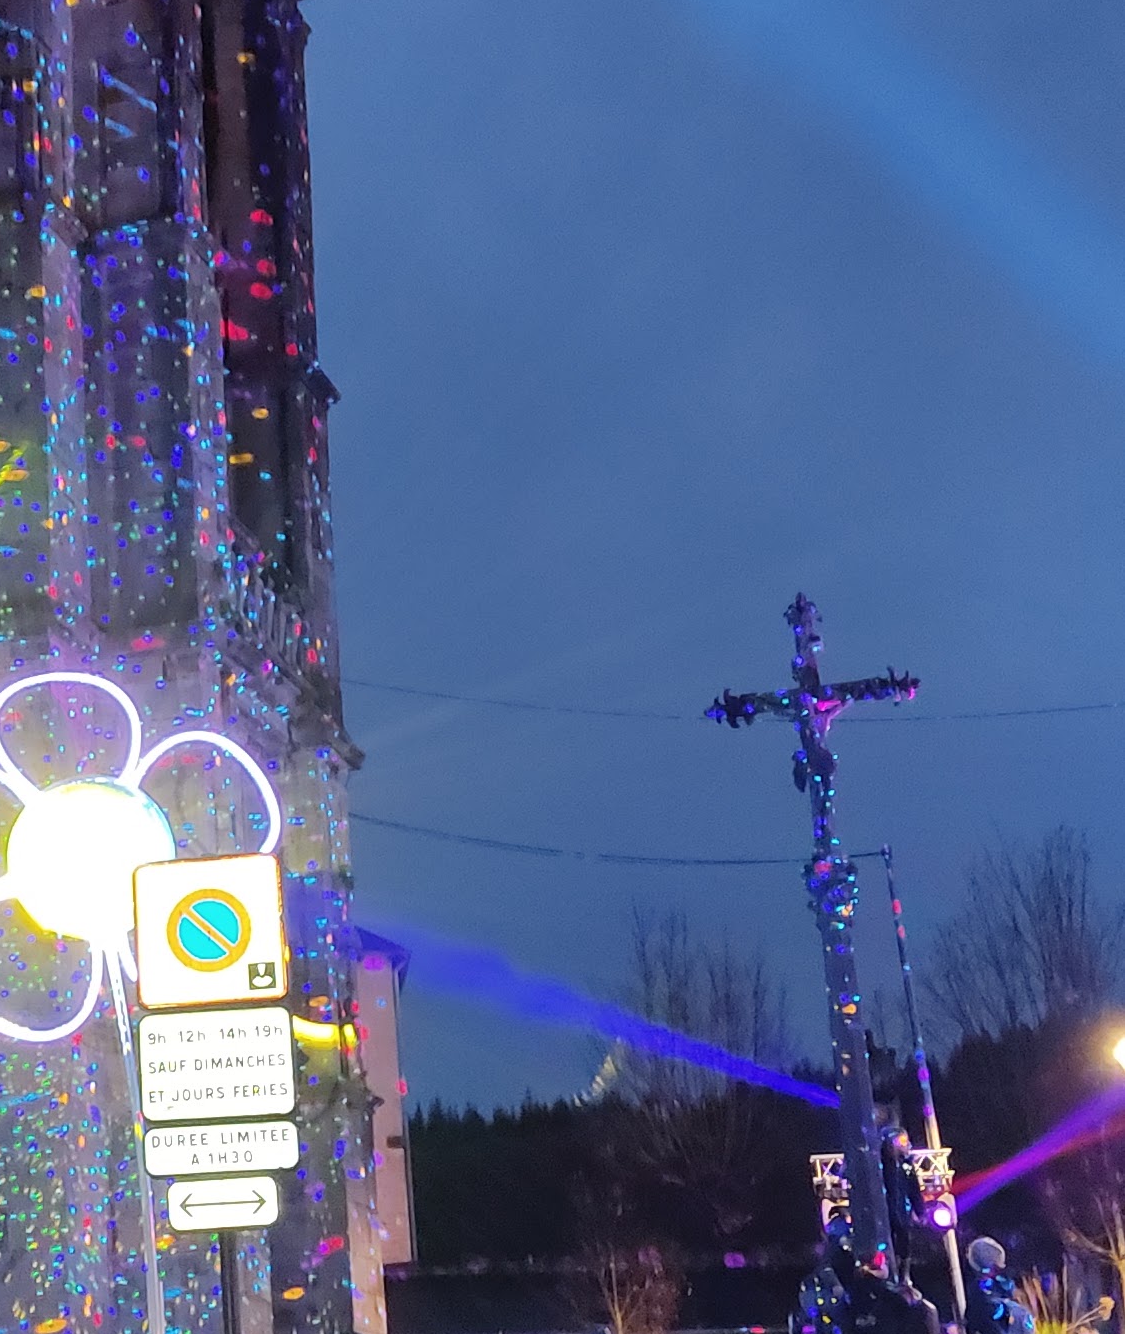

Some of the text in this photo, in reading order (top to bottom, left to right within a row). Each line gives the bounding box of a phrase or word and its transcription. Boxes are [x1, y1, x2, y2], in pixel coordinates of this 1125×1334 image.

[148, 1025, 283, 1044] 9h 12h 14h 19h
[149, 1054, 286, 1074] SAUF DIMANCHES
[149, 1083, 288, 1103] ET JOURS FERIES
[152, 1128, 290, 1148] DUREE LIMITEE
[191, 1151, 253, 1165] A 1H30
